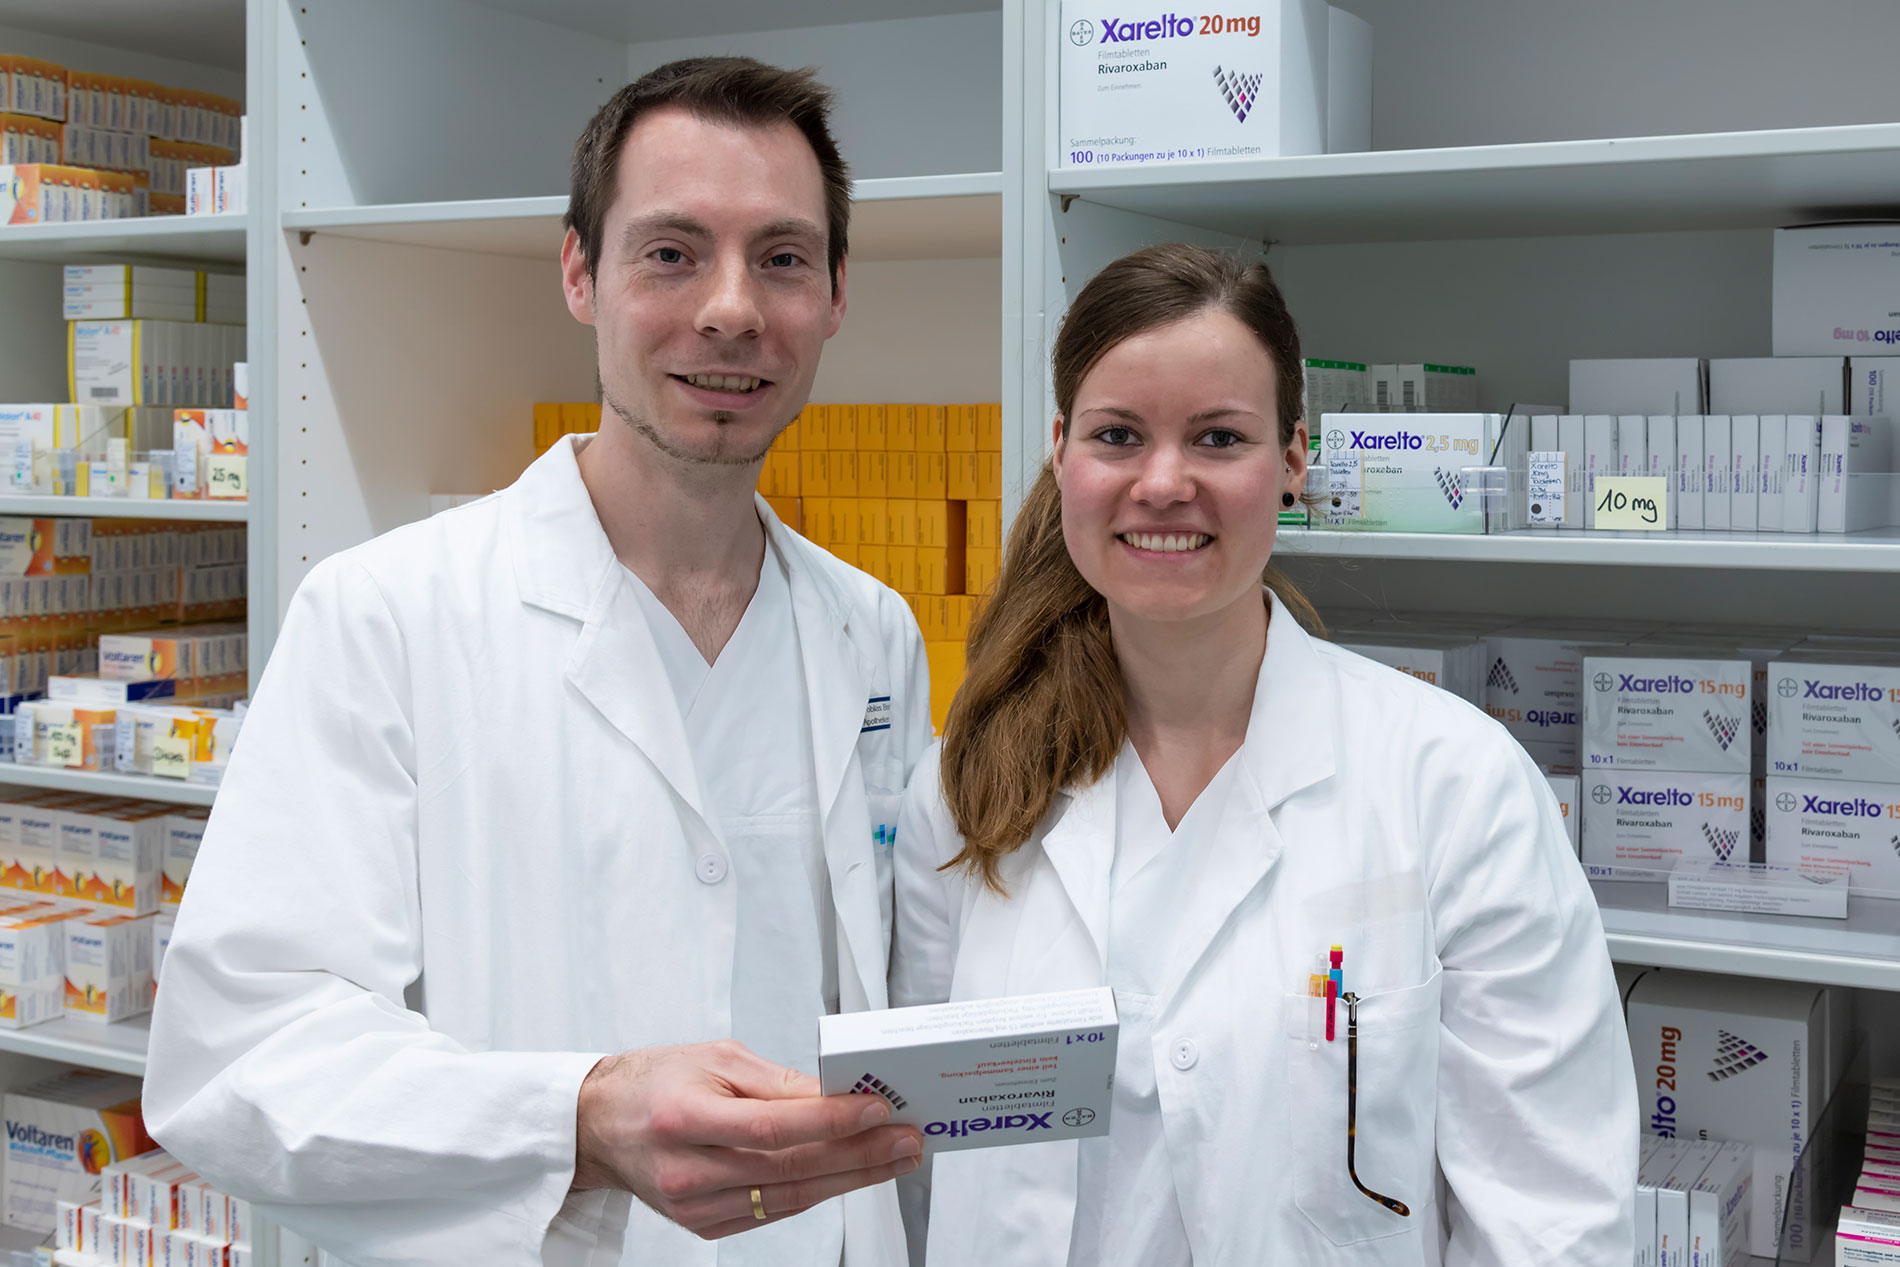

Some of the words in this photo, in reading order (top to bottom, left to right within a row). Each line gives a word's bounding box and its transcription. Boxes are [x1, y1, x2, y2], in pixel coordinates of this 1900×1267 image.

[1100, 13, 1194, 43] Xarelto
[1199, 14, 1223, 35] 20
[1226, 15, 1261, 37] mg
[1097, 48, 1150, 60] Filmtabletten
[1098, 60, 1167, 75] Rivaroxaban
[1070, 151, 1093, 164] 100
[1097, 153, 1110, 164] (10
[1112, 151, 1154, 162] Packungen
[1156, 151, 1165, 159] zu
[1167, 150, 1175, 160] je
[1178, 149, 1188, 158] 10
[1197, 148, 1205, 158] 1)
[1207, 145, 1261, 157] Filmtabletten
[1350, 431, 1422, 450] Xarelto
[1426, 436, 1449, 452] 2,5
[1454, 438, 1479, 455] mg
[212, 467, 226, 483] 25
[1597, 488, 1627, 512] 10
[1632, 498, 1658, 523] mg
[1618, 674, 1694, 693] Xarelto
[1699, 680, 1716, 694] 15
[1719, 681, 1745, 698] mg
[1803, 680, 1883, 702] Xarelto
[866, 704, 882, 713] obias
[1618, 706, 1674, 715] Rivaroxaban
[1508, 709, 1522, 722] 15
[1802, 713, 1862, 724] Rivaroxaban
[1591, 755, 1600, 763] 10
[1775, 761, 1785, 771] 10
[1617, 787, 1692, 806] Xarelto
[1698, 793, 1715, 807] 15
[1717, 795, 1744, 812] mg
[1802, 795, 1882, 817] Xarelto
[1616, 818, 1673, 828] Rivaroxaban
[1801, 827, 1860, 839] Rivaroxaban
[1589, 866, 1599, 875] 10
[990, 1036, 1059, 1049] Filmtabletten
[1066, 1035, 1072, 1045] 1
[1088, 1032, 1105, 1042] 10
[1661, 1026, 1682, 1061] mg
[1791, 1040, 1800, 1098] Filmtabletten
[1657, 1065, 1677, 1091] 20
[959, 1090, 1055, 1104] Rivaroxaban
[982, 1101, 1055, 1112] Filmtabletten
[1792, 1100, 1802, 1108] 1)
[924, 1111, 1053, 1137] Xarelto
[1792, 1119, 1800, 1130] 10
[6, 1120, 74, 1151] Voltaren
[1791, 1132, 1802, 1140] je
[1793, 1143, 1800, 1153] zu
[1790, 1224, 1803, 1249] 100
